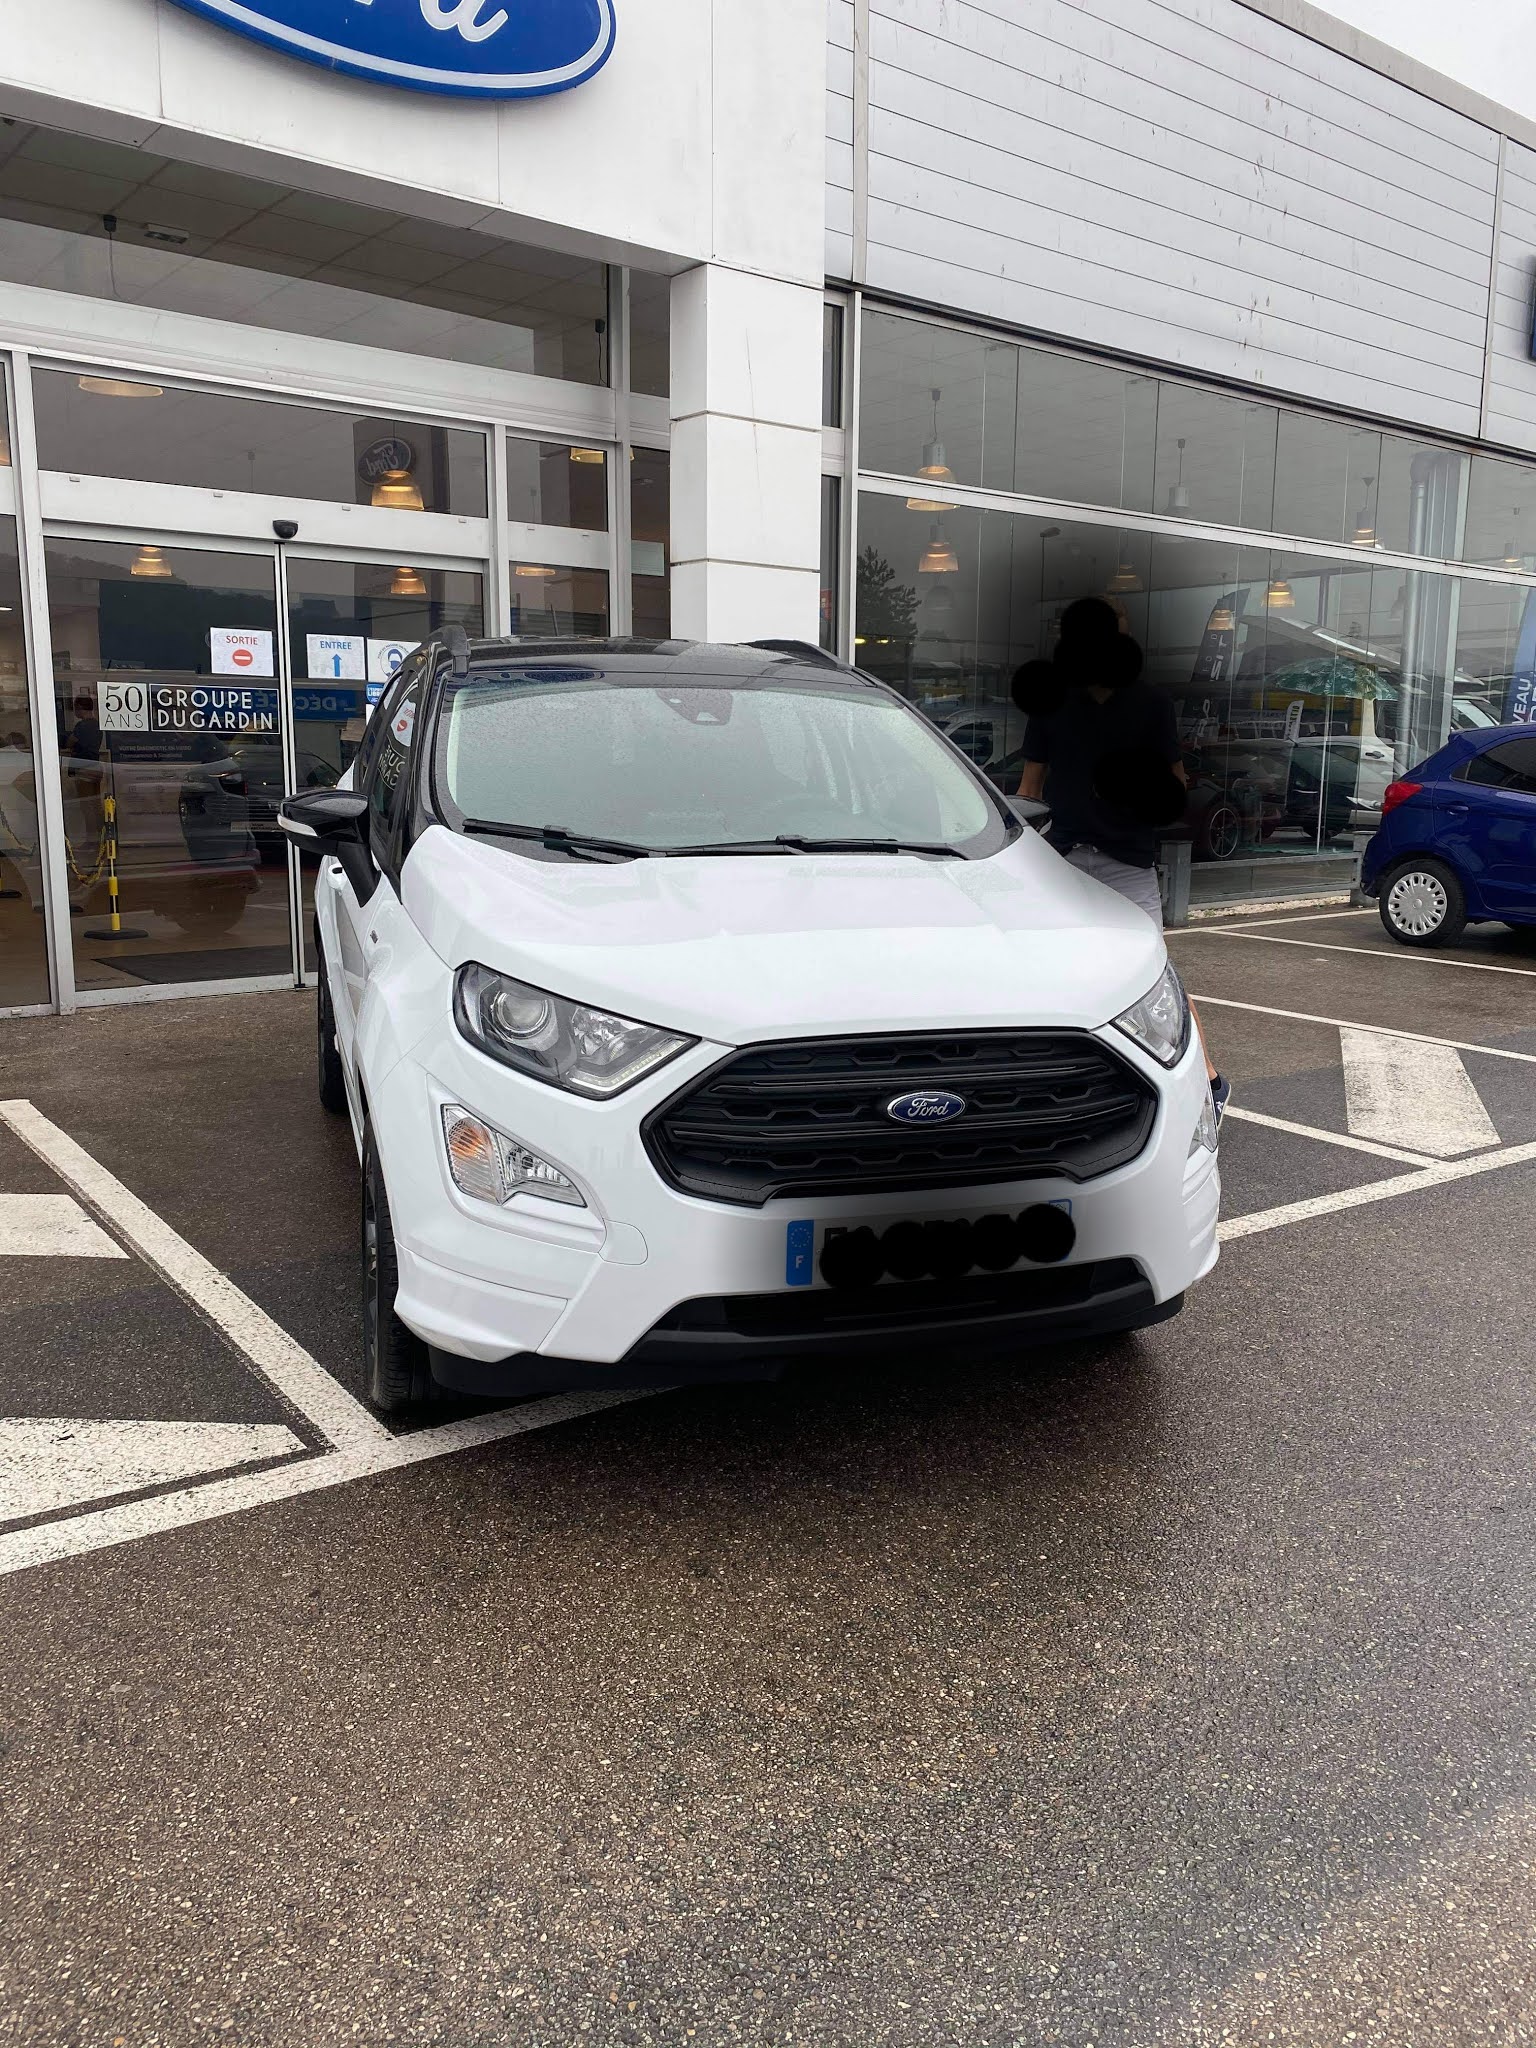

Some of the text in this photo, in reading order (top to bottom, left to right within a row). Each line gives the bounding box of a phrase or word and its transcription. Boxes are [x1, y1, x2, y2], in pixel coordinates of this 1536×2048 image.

[226, 635, 259, 646] SORTIE
[319, 640, 353, 651] ENTREE
[105, 685, 143, 713] 50
[156, 688, 252, 709] GROUPE
[104, 713, 144, 729] ANS
[157, 709, 273, 730] DUGARDIN
[906, 1097, 950, 1118] Ford
[795, 1254, 804, 1269] F
